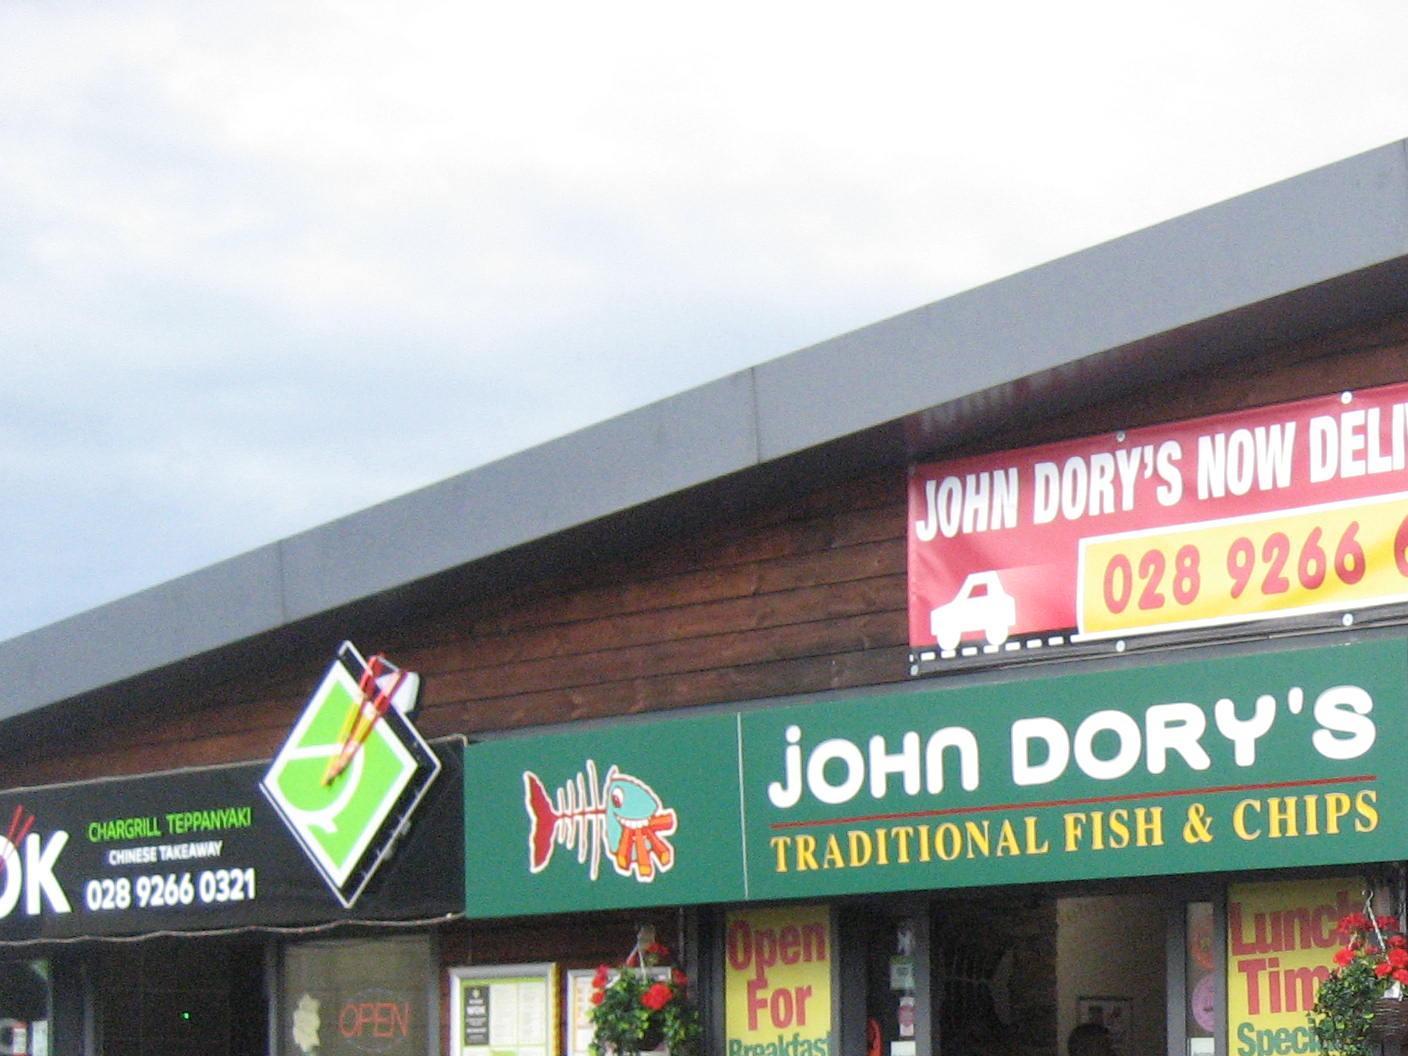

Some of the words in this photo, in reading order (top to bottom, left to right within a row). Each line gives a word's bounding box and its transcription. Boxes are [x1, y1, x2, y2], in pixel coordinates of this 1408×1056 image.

[915, 467, 1019, 541] JOHN
[1033, 440, 1183, 526] DORY'S
[1197, 421, 1296, 500] NOW
[1103, 544, 1201, 614] 028
[1227, 521, 1366, 599] 9266
[1011, 685, 1377, 787] DORY'S
[88, 816, 161, 843] CHARGRILL
[166, 807, 251, 835] TEPPANYAKI
[109, 846, 157, 865] CHINESE
[158, 840, 223, 861] TAKEAWAY
[770, 816, 1049, 873] TRADITIONAL
[1063, 805, 1165, 852] FISH
[1182, 803, 1214, 843] &
[1232, 790, 1379, 842] CHIPS
[86, 878, 131, 911] 028
[136, 872, 194, 908] 9266
[200, 868, 256, 903] 0321
[728, 919, 827, 981] Open
[747, 979, 812, 1031] For
[1237, 957, 1331, 1015] Tim
[338, 1001, 410, 1037] OPEN
